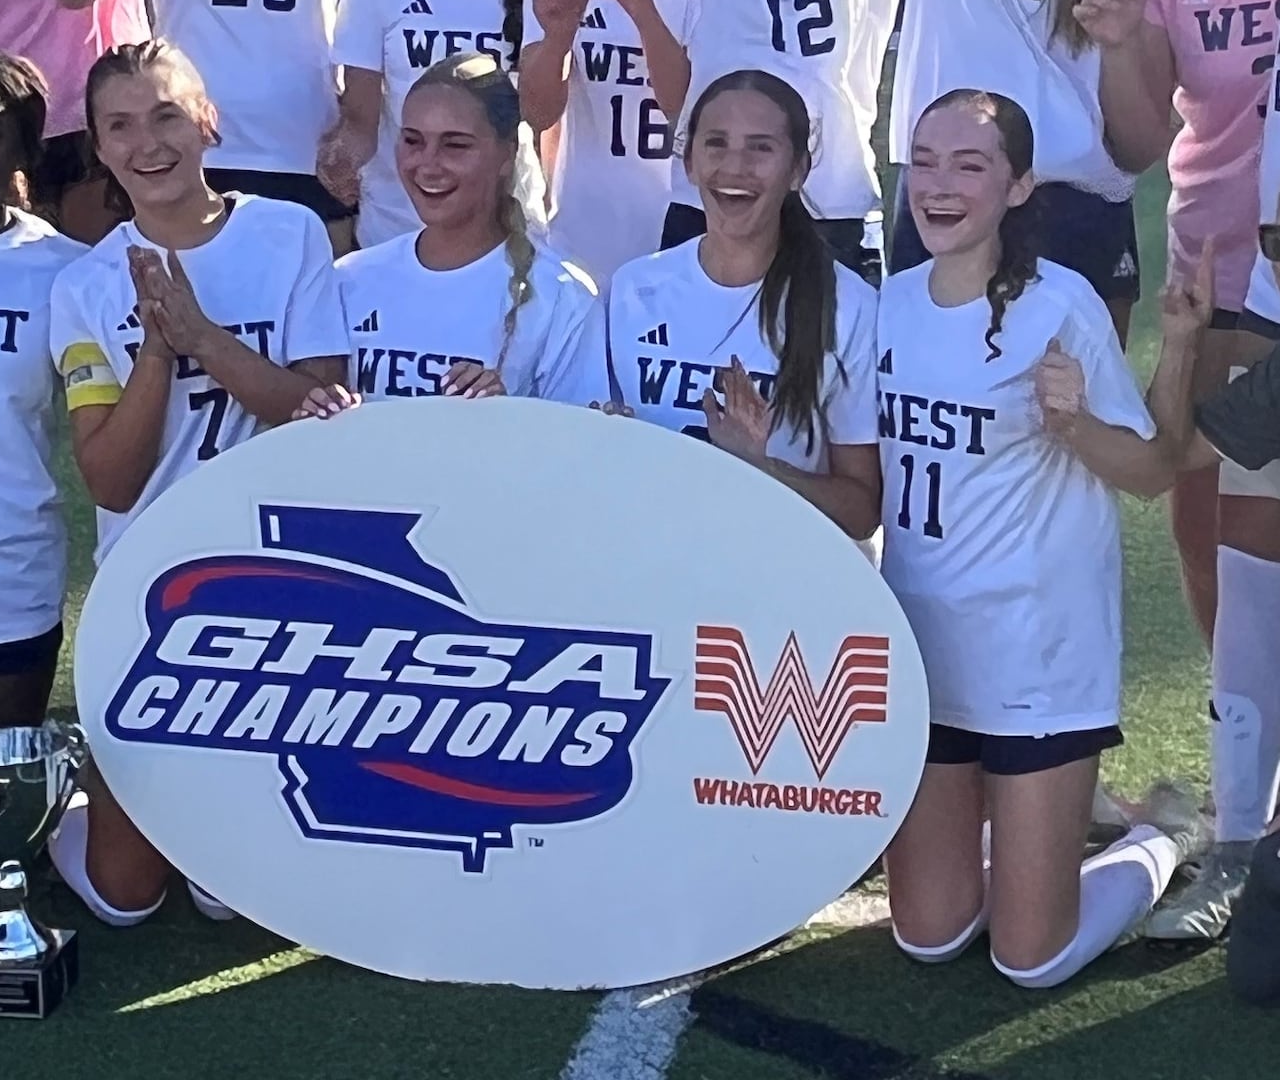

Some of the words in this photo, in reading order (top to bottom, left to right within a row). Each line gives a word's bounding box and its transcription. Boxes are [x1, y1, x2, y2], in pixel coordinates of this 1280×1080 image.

[402, 28, 519, 71] WES
[581, 41, 653, 88] WE
[610, 94, 673, 160] 16
[189, 388, 228, 461] 7
[898, 454, 943, 539] 11
[154, 614, 648, 700] GHSA
[117, 674, 629, 767] CHAMPIONS
[693, 777, 883, 816] WHATABURGER
